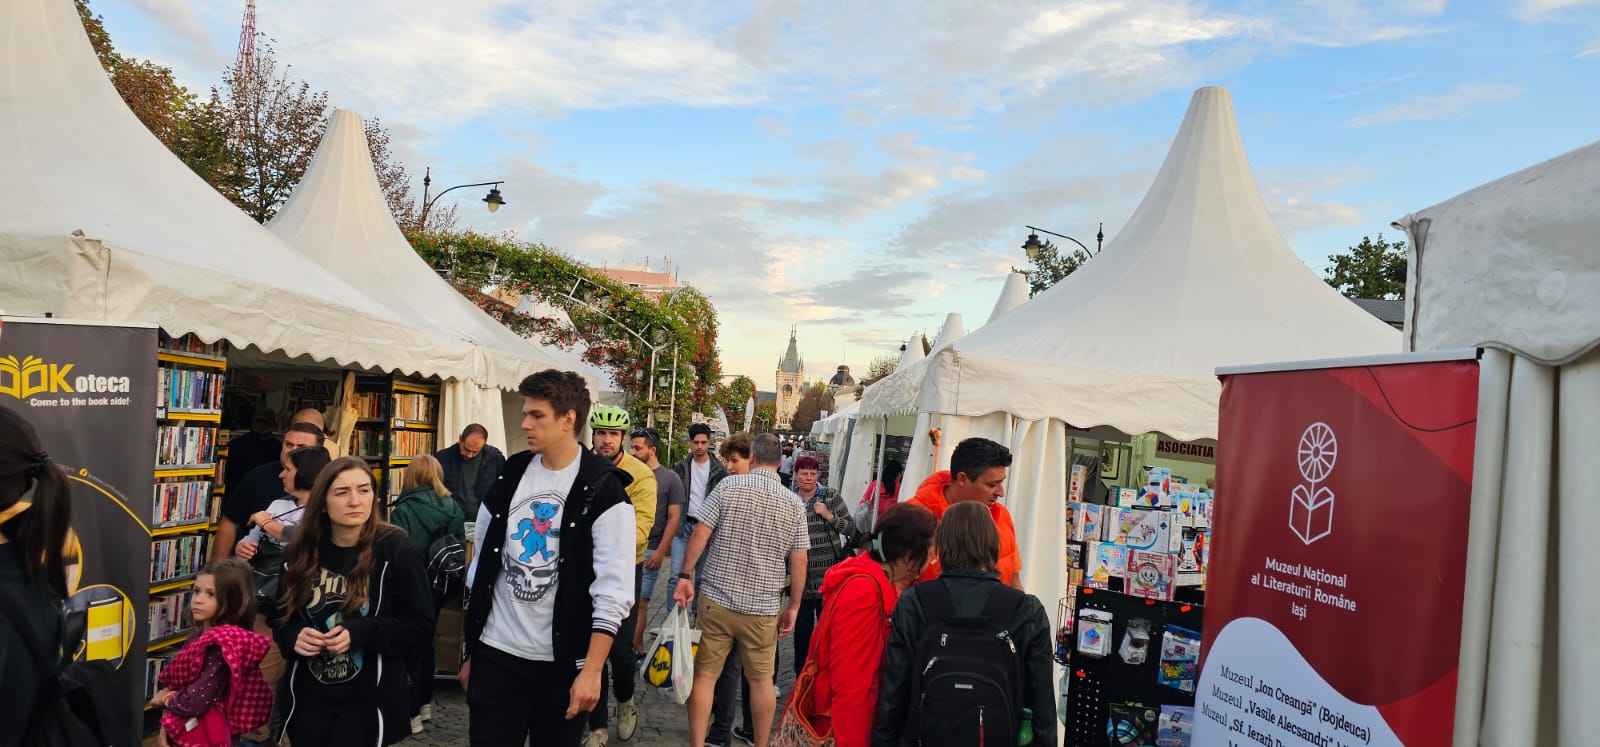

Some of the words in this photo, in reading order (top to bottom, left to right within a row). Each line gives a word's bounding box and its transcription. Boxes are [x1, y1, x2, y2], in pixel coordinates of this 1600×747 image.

[30, 398, 58, 407] Come
[60, 398, 70, 407] to
[71, 397, 87, 406] the
[88, 397, 108, 406] book
[110, 396, 130, 406] side!
[1157, 440, 1214, 458] ASOCIATIA
[1265, 556, 1301, 577] Muzeul
[1303, 565, 1347, 588] Național
[1250, 573, 1260, 586] al
[1263, 574, 1311, 600] Literaturii
[1314, 588, 1357, 612] Române
[1291, 601, 1308, 621] Iași
[1212, 684, 1243, 709] Muzeul
[1220, 664, 1254, 689] Muzeul
[1255, 680, 1274, 698] „Ion
[1318, 705, 1371, 746] (Bojdeuca)
[1201, 701, 1228, 727] Muzeul
[1247, 724, 1274, 747] Ierarh
